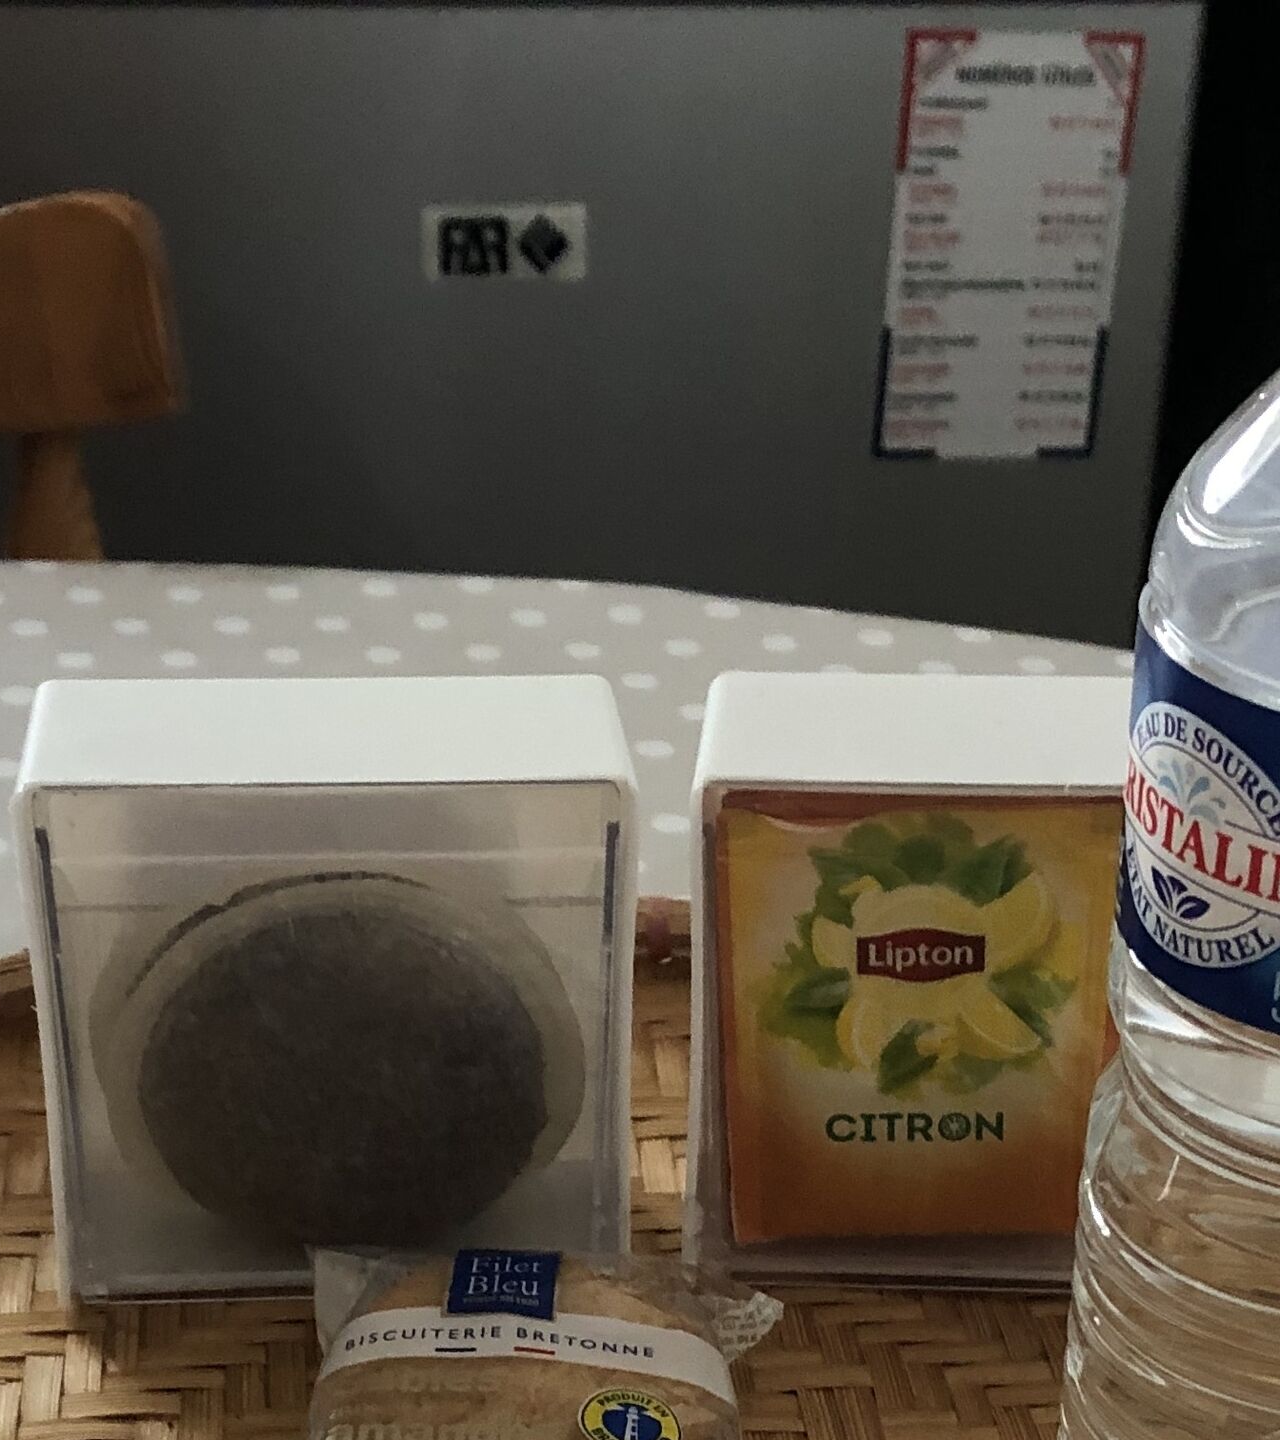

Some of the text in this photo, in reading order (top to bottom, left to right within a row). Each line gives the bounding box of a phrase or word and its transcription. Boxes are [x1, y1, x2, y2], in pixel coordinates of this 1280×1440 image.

[1163, 711, 1187, 743] DE
[867, 941, 974, 972] Lipton
[1154, 927, 1276, 965] NATUREL
[825, 1111, 1005, 1143] CITRON
[470, 1256, 544, 1274] Filet
[466, 1273, 541, 1296] Bleu
[344, 1324, 656, 1360] BISCUITERIE BRETONNE
[596, 1391, 653, 1407] PRODUIT
